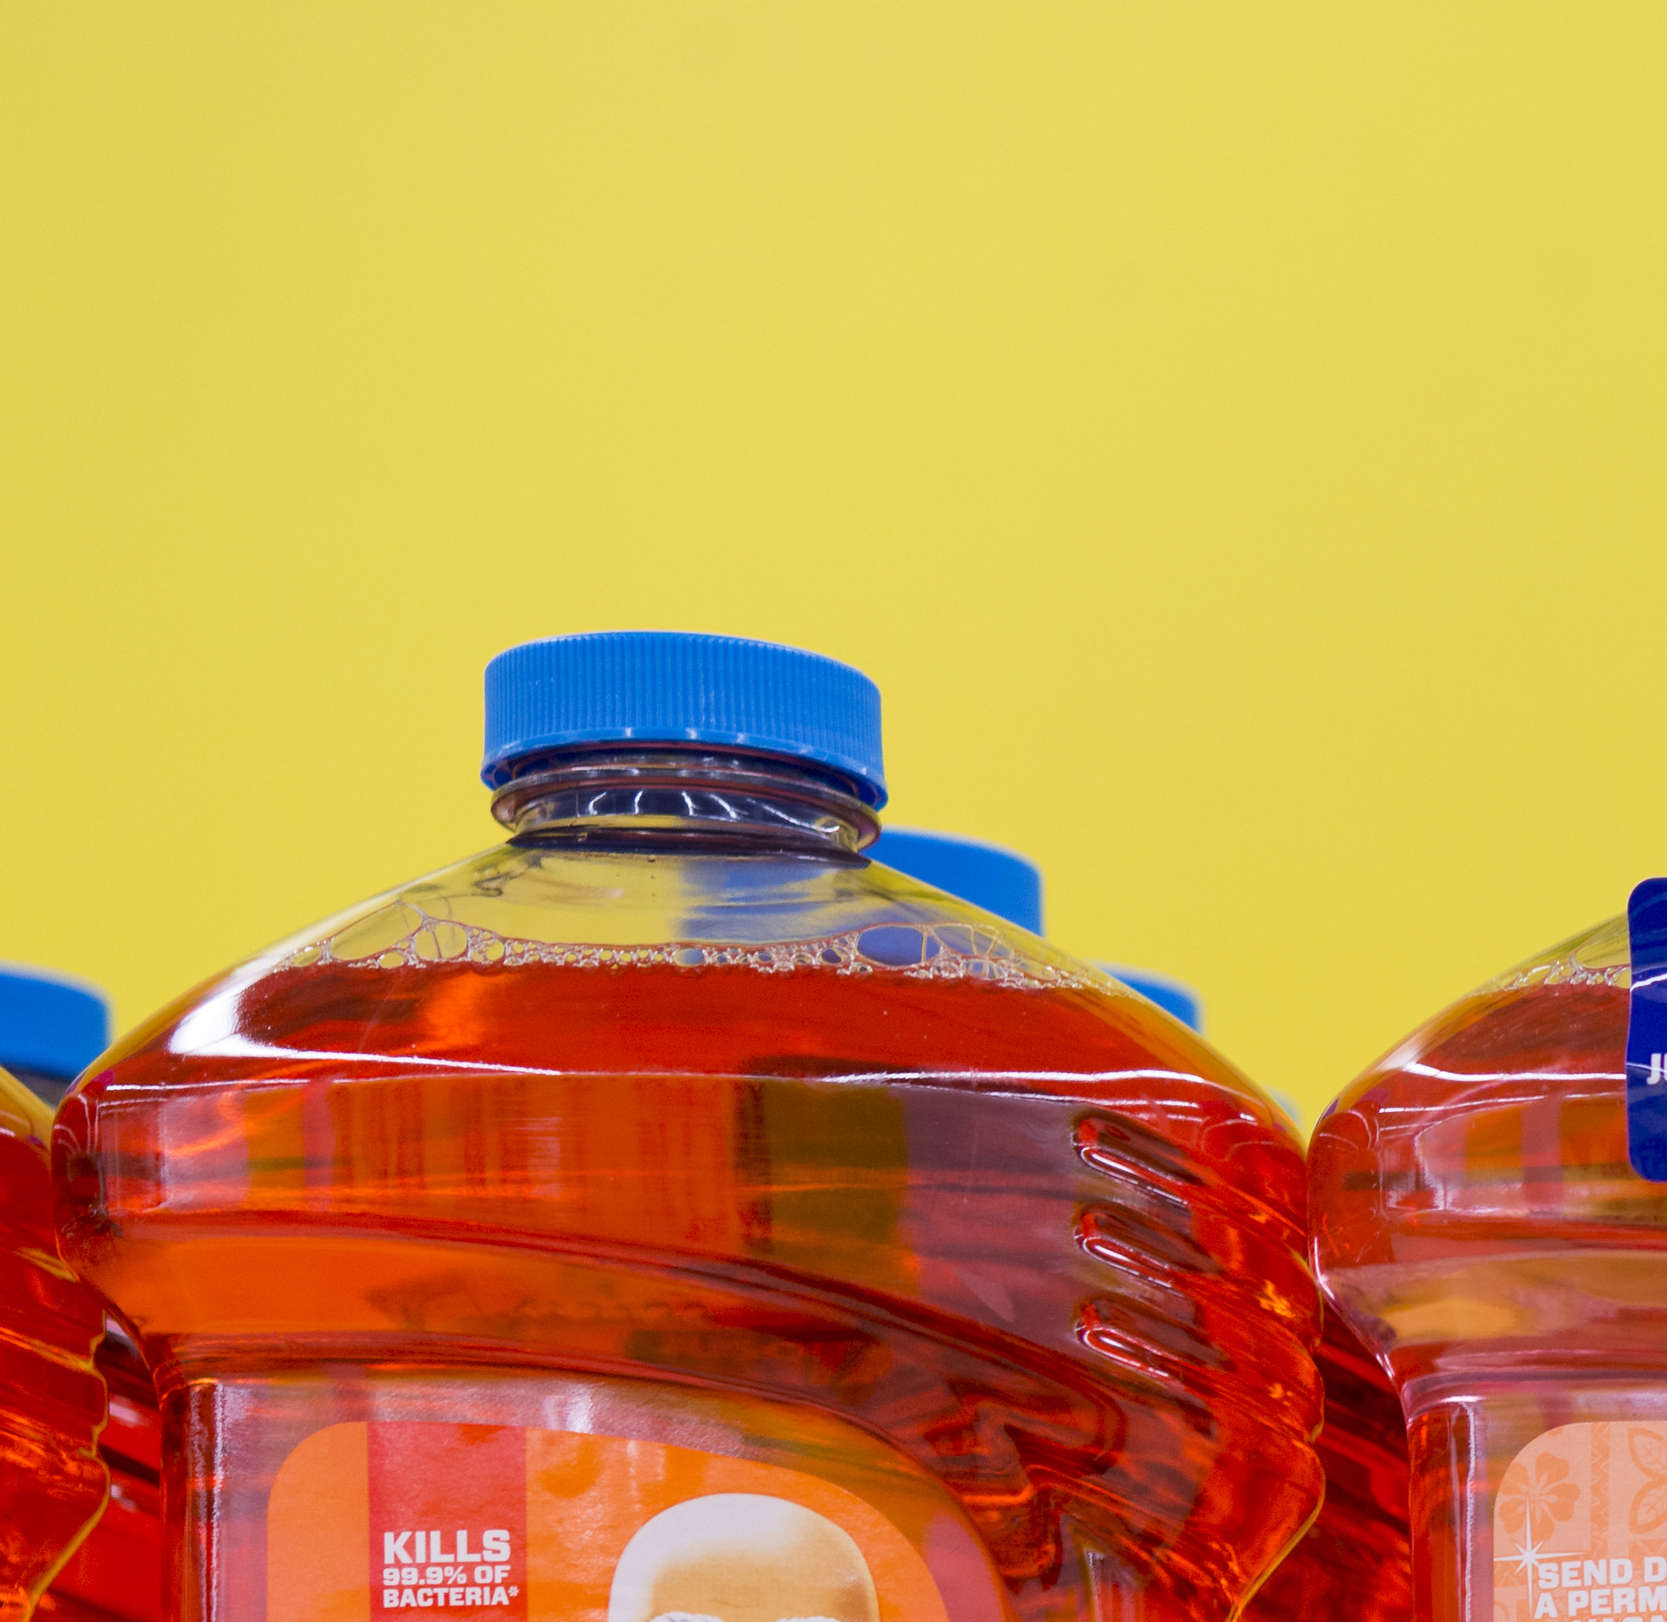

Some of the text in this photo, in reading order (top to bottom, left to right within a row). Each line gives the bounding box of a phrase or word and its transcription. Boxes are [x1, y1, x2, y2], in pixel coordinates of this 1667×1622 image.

[383, 1529, 511, 1564] KILLS
[382, 1567, 511, 1586] 99.9% OF
[1538, 1559, 1638, 1589] SEND
[1533, 1591, 1559, 1619] A
